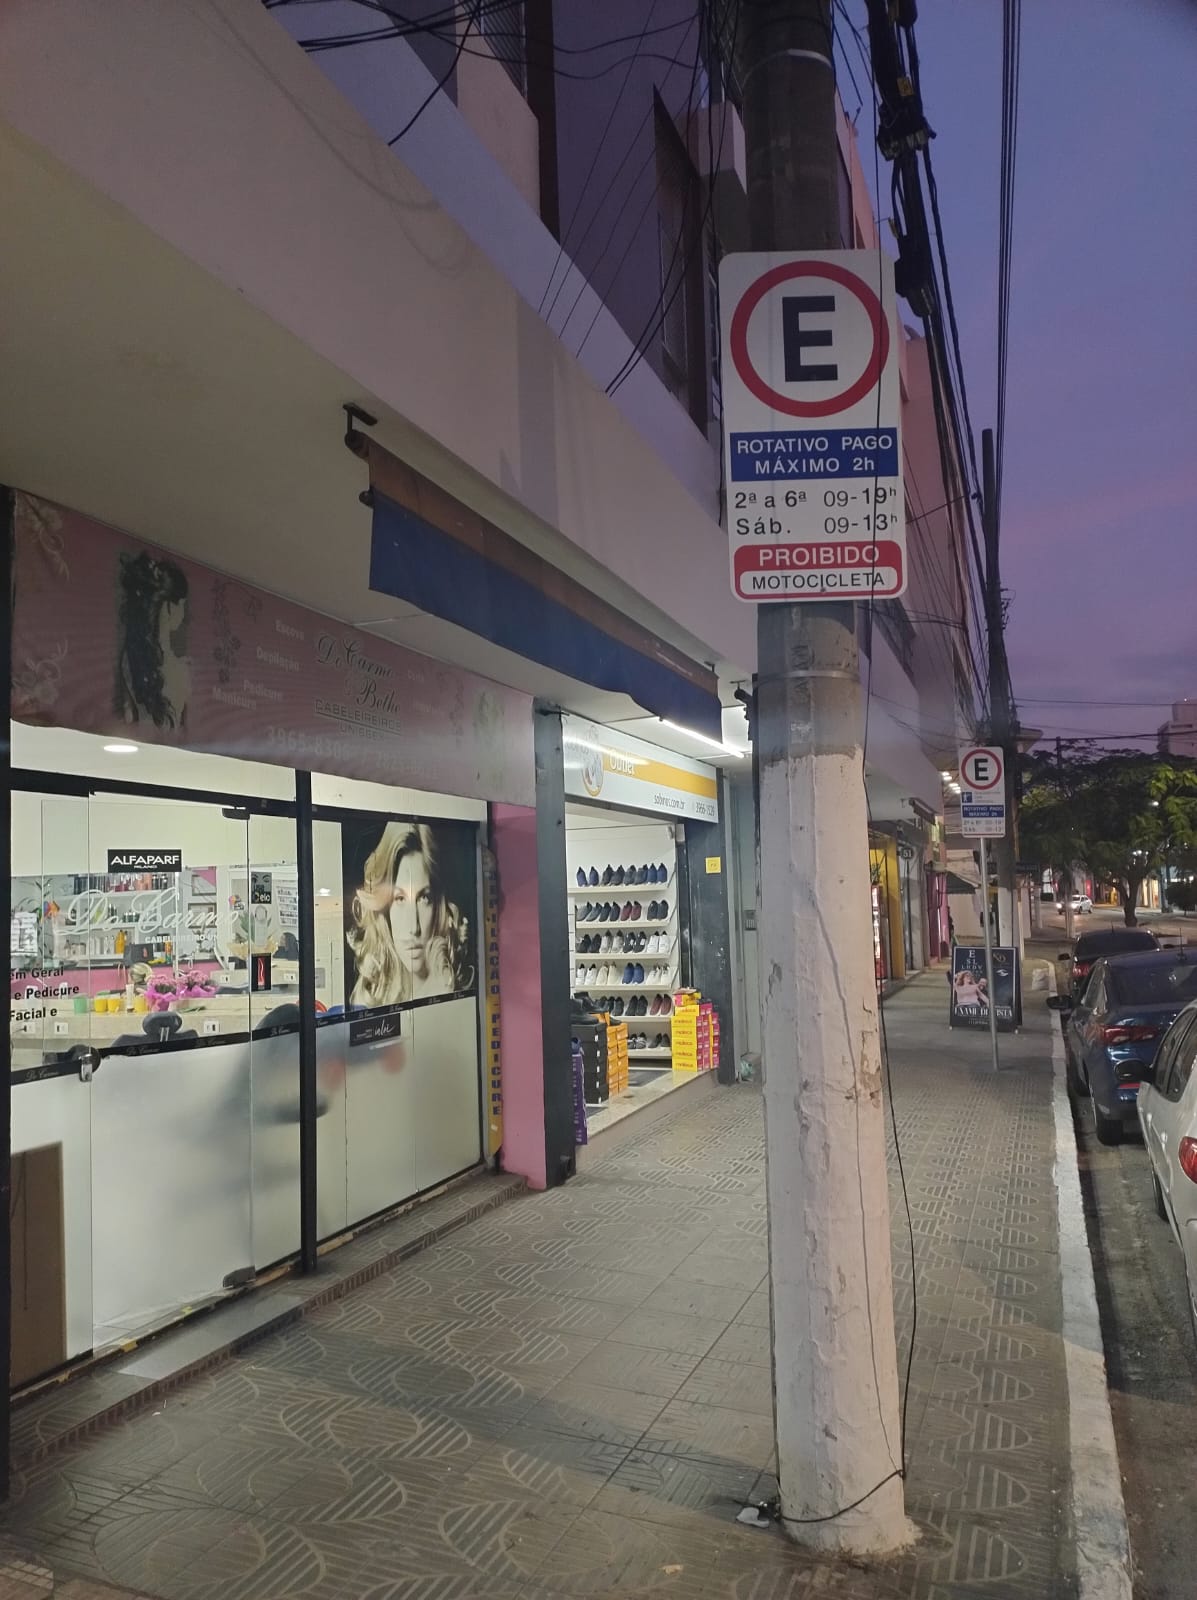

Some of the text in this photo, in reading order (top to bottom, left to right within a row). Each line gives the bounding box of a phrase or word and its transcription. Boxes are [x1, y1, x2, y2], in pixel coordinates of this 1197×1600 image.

[782, 296, 838, 382] E
[737, 434, 892, 455] ROTATIVO PAGO
[755, 456, 875, 475] MÁXIMO 2h
[764, 495, 775, 508] a
[785, 489, 807, 508] 6ª
[736, 517, 791, 536] Sáb.
[759, 544, 880, 567] PROIBIDO
[752, 572, 884, 590] MOTOCICLETA
[974, 758, 989, 781] E
[111, 855, 180, 866] ALFAPARF
[32, 966, 64, 979] Geral
[15, 985, 79, 1001] e Pedicure
[50, 1007, 58, 1017] e
[491, 1013, 502, 1116] PEDICURE
